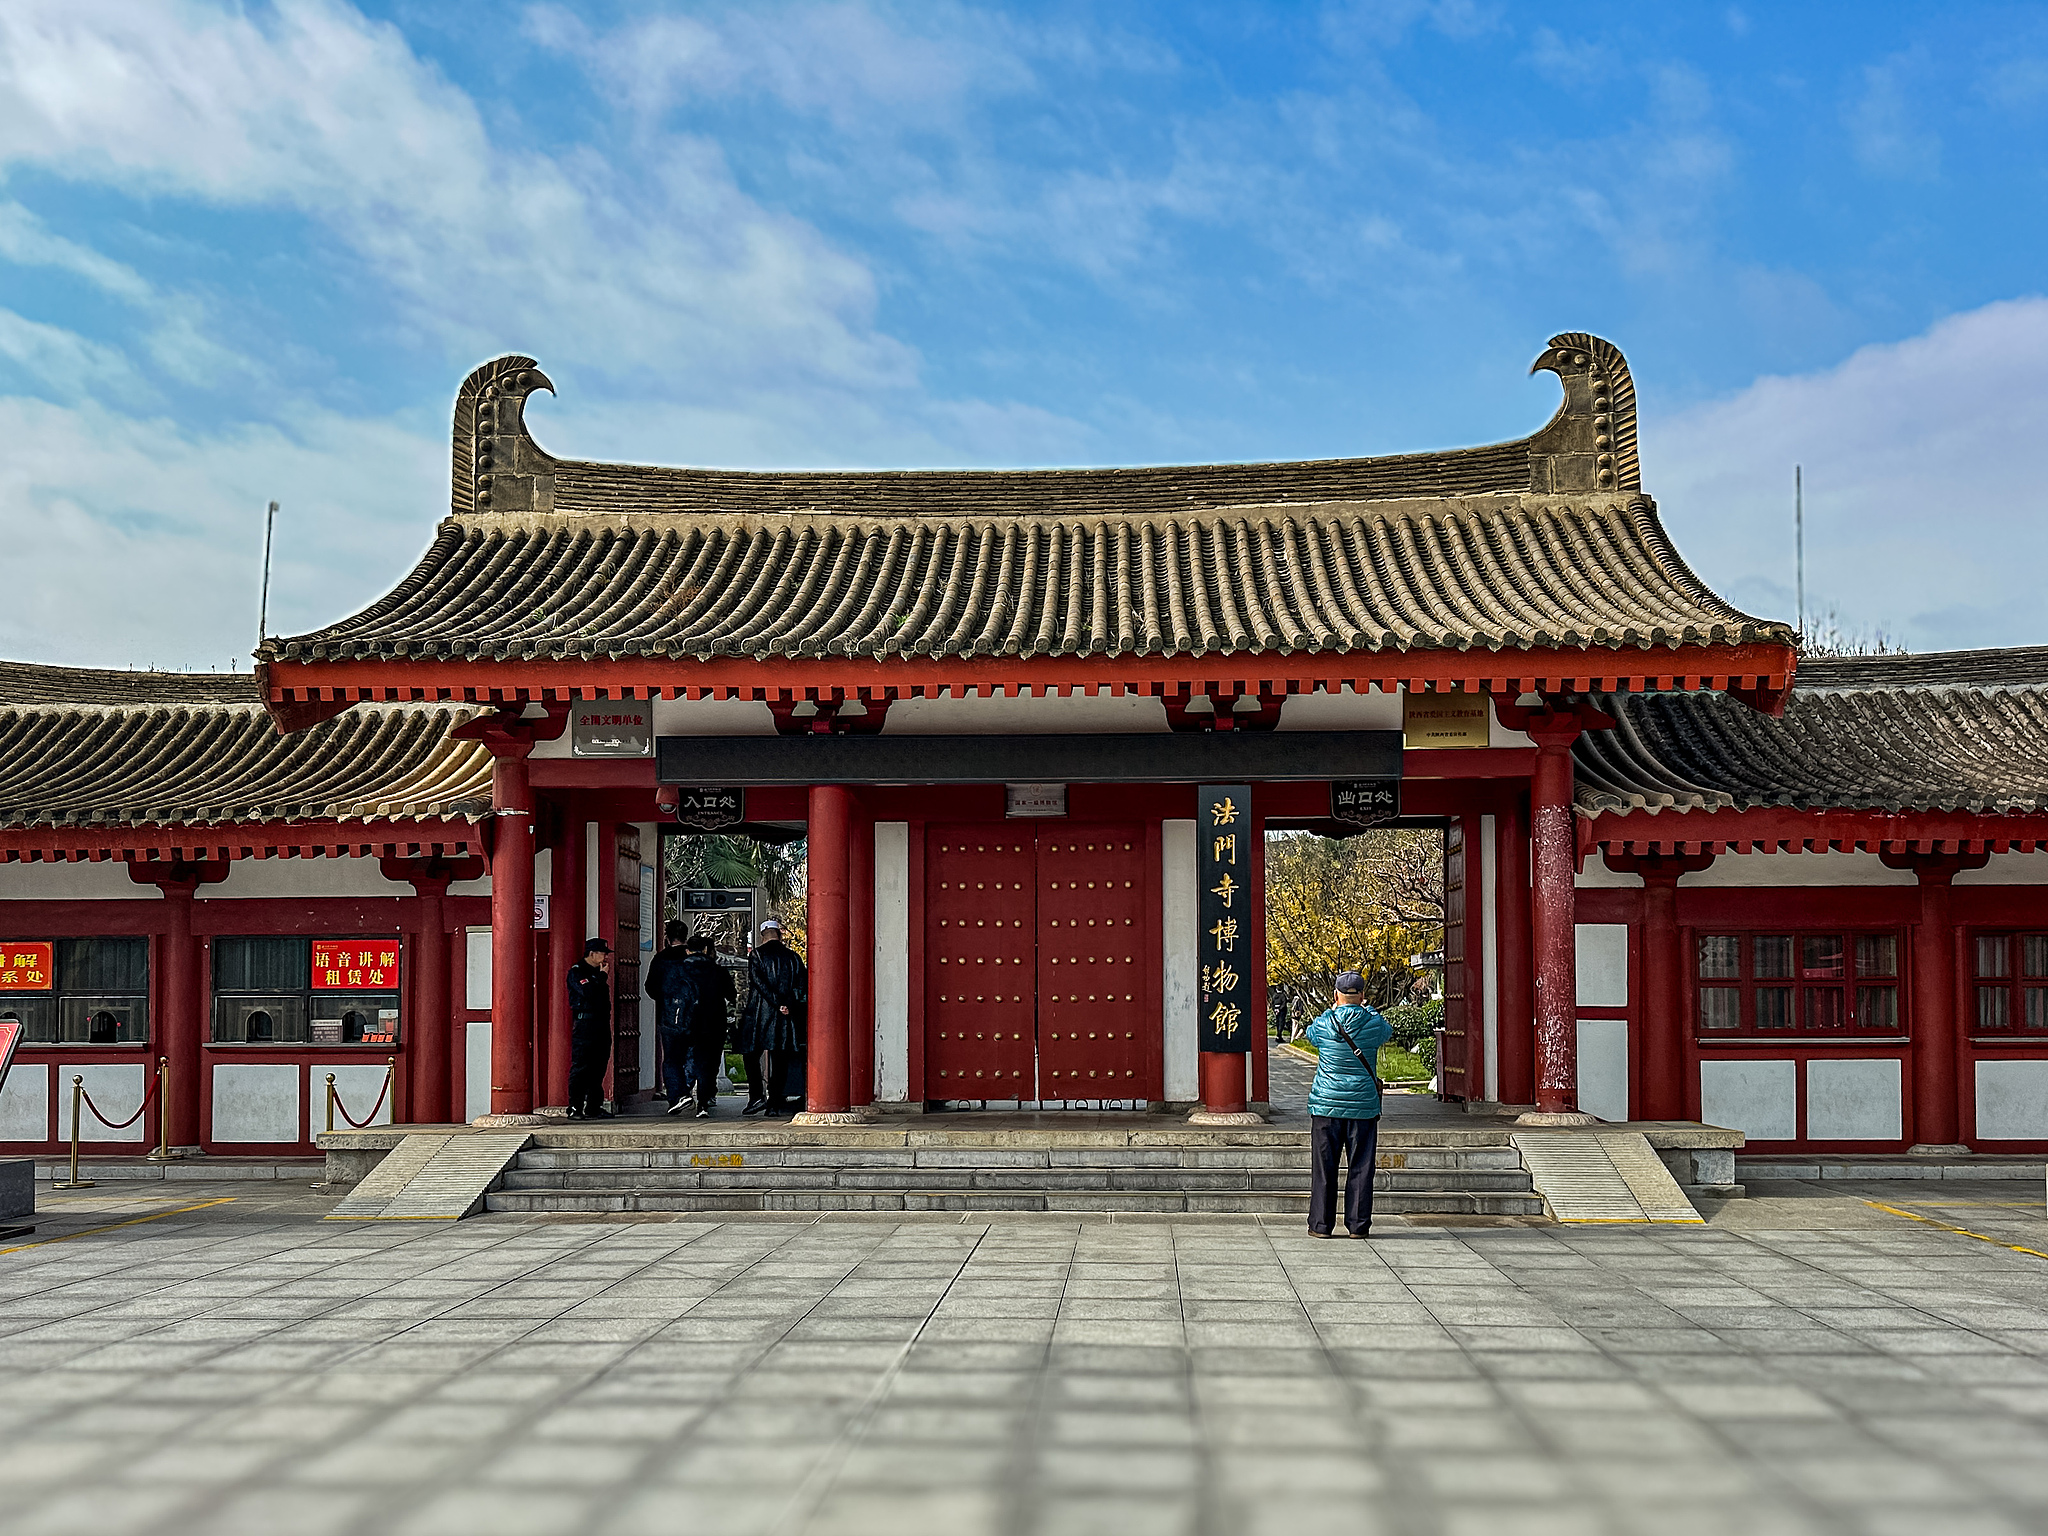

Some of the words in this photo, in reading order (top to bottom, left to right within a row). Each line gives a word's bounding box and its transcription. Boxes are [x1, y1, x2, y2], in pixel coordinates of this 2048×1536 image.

[579, 714, 644, 727] 全国文明单位
[684, 795, 736, 809] 入口处
[1338, 790, 1394, 805] 出口处
[0, 953, 38, 968] 解
[315, 951, 396, 968] 语音讲解
[325, 968, 384, 986] 租赁处
[1376, 1154, 1405, 1168] 台阶
